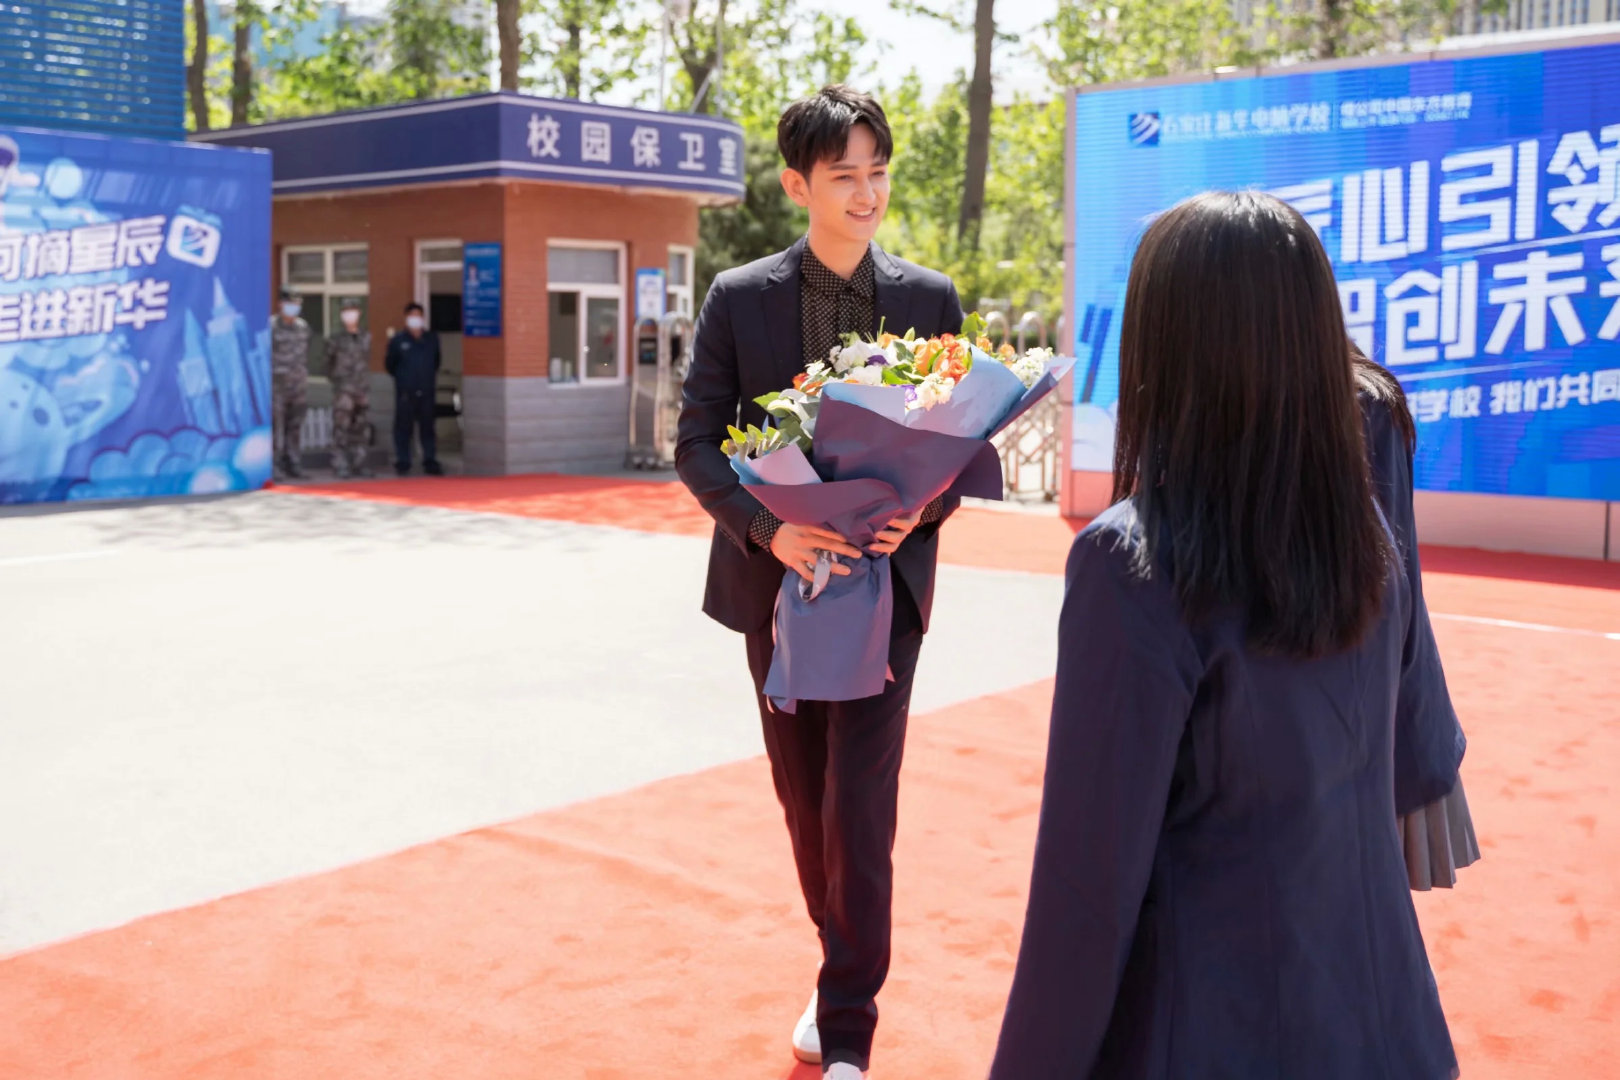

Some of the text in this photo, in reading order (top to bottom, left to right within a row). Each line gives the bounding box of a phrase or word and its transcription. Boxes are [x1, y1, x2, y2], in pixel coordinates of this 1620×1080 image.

[527, 113, 737, 176] 校园保卫室
[1337, 243, 1620, 366] 创未
[1408, 385, 1482, 423] 学校
